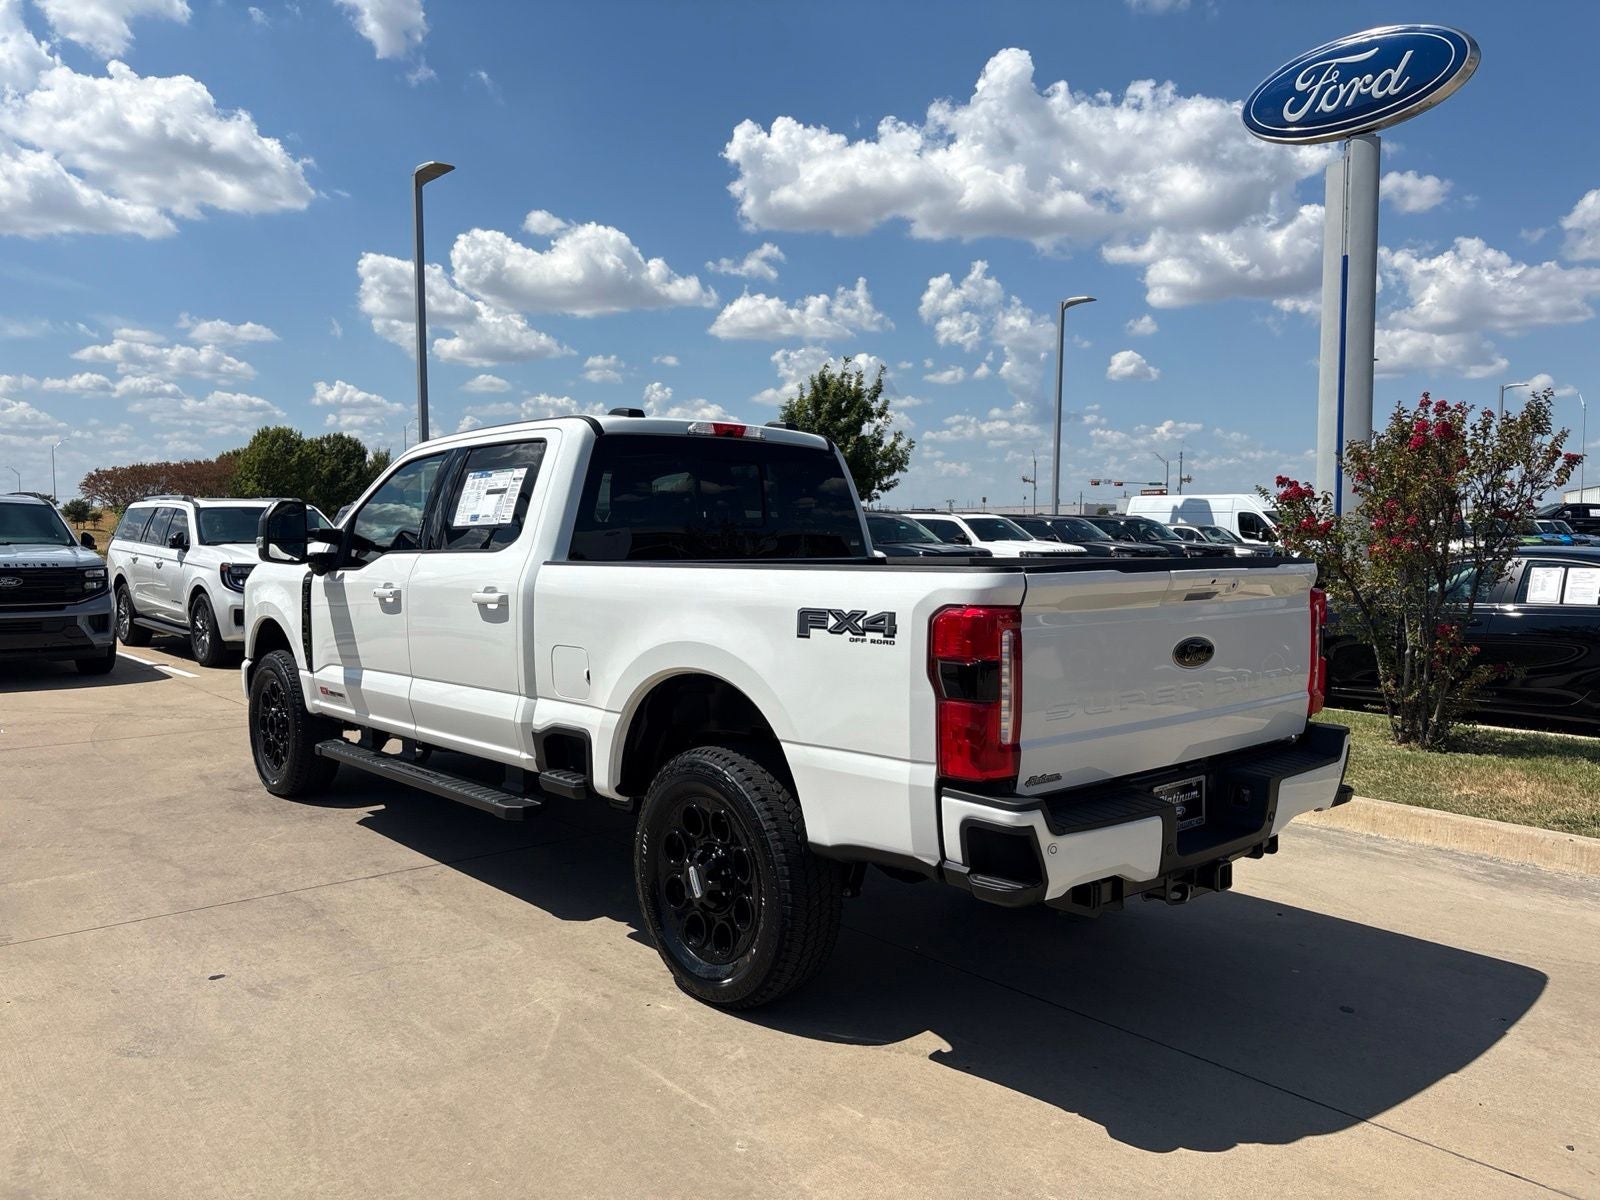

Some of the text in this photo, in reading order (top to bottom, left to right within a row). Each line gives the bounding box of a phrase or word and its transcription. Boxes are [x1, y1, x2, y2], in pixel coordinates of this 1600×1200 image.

[1282, 46, 1415, 123] Ford
[796, 606, 898, 639] FX4
[869, 638, 896, 646] ROAD
[1043, 681, 1205, 722] SUPER
